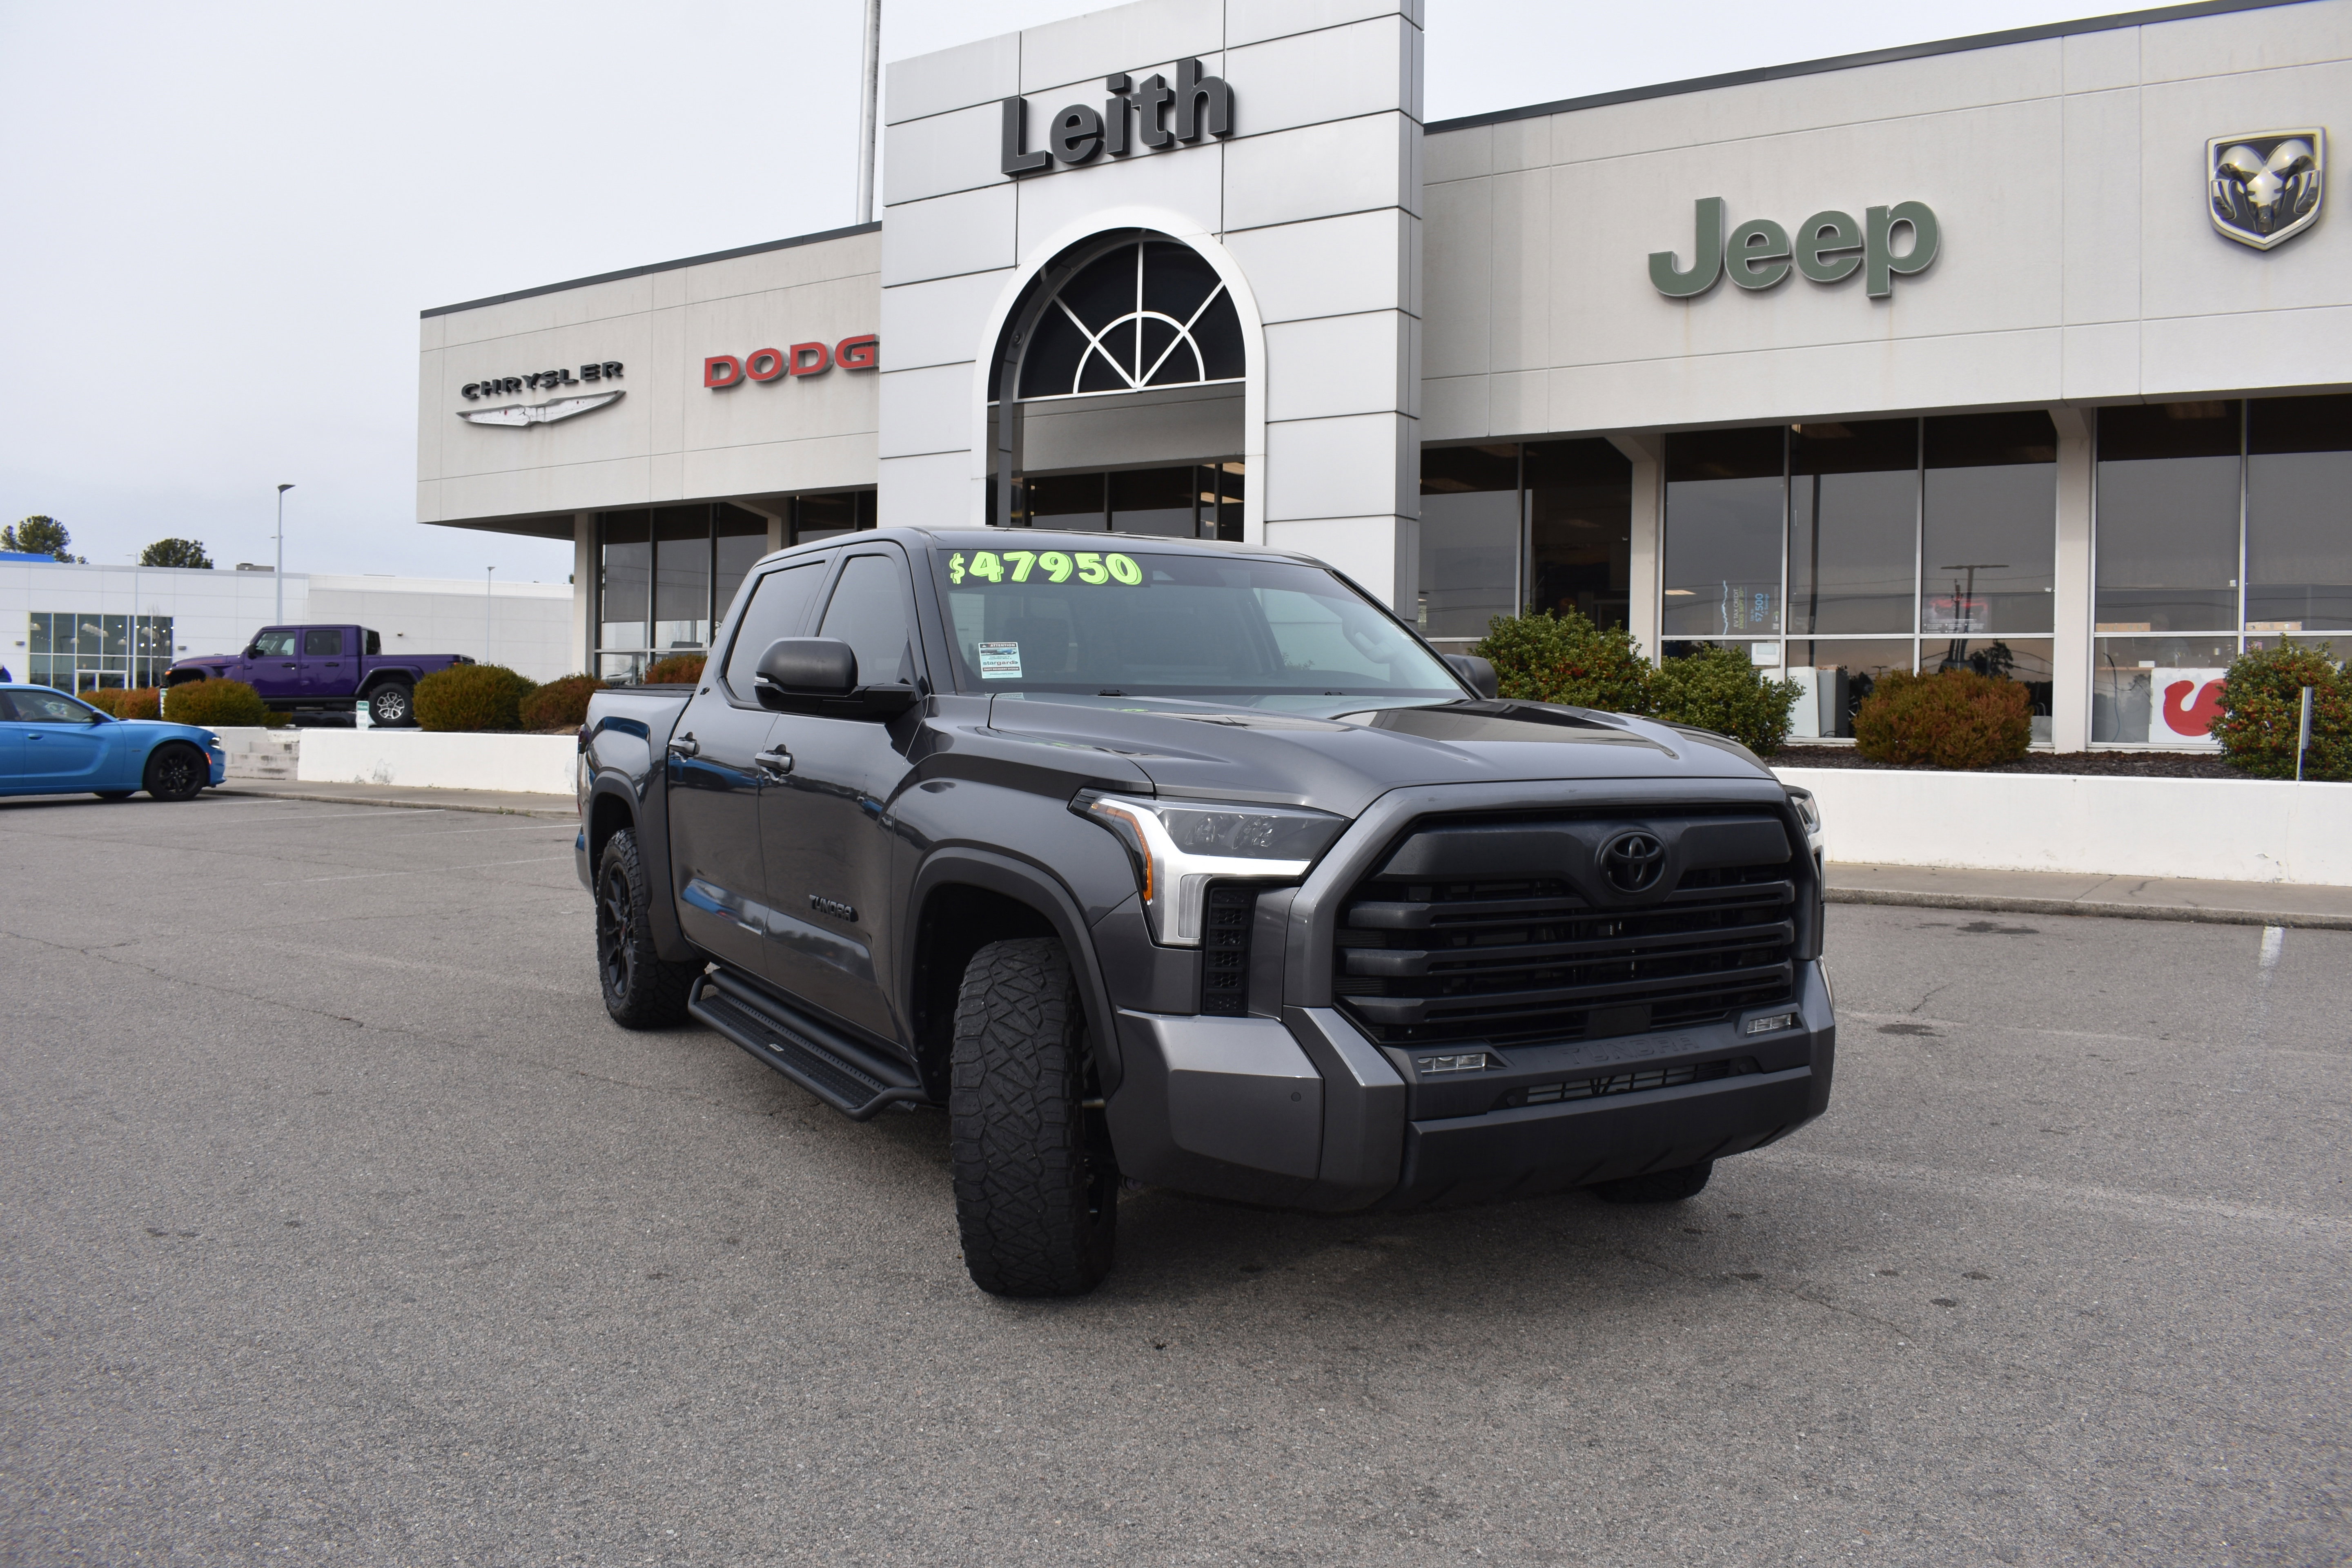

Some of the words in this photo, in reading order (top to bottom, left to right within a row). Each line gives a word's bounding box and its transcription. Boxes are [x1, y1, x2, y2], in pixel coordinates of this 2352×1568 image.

[1001, 57, 1235, 178] Leith
[1647, 196, 1943, 301] Jeep
[704, 334, 880, 389] DODG
[461, 361, 624, 399] CHRYSLER
[949, 551, 1142, 585] $47950
[1755, 593, 1764, 622] $7,500
[809, 894, 859, 922] TUNDRA
[1560, 1033, 1700, 1065] TUNDRA
